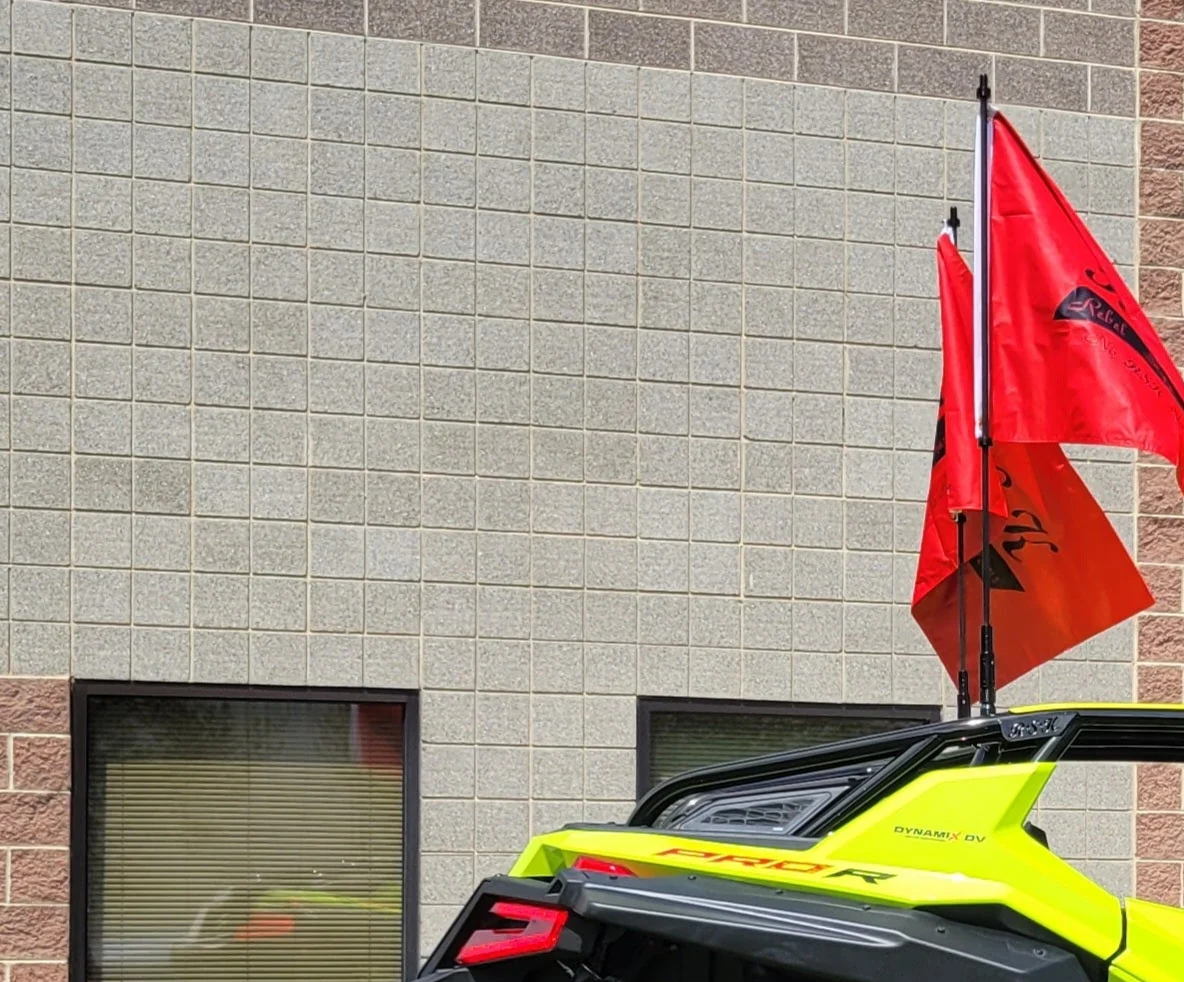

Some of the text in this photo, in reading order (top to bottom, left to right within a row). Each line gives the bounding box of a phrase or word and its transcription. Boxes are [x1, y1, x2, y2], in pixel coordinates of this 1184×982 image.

[894, 826, 986, 843] DYNAMIX DV
[654, 847, 898, 885] PRO R
